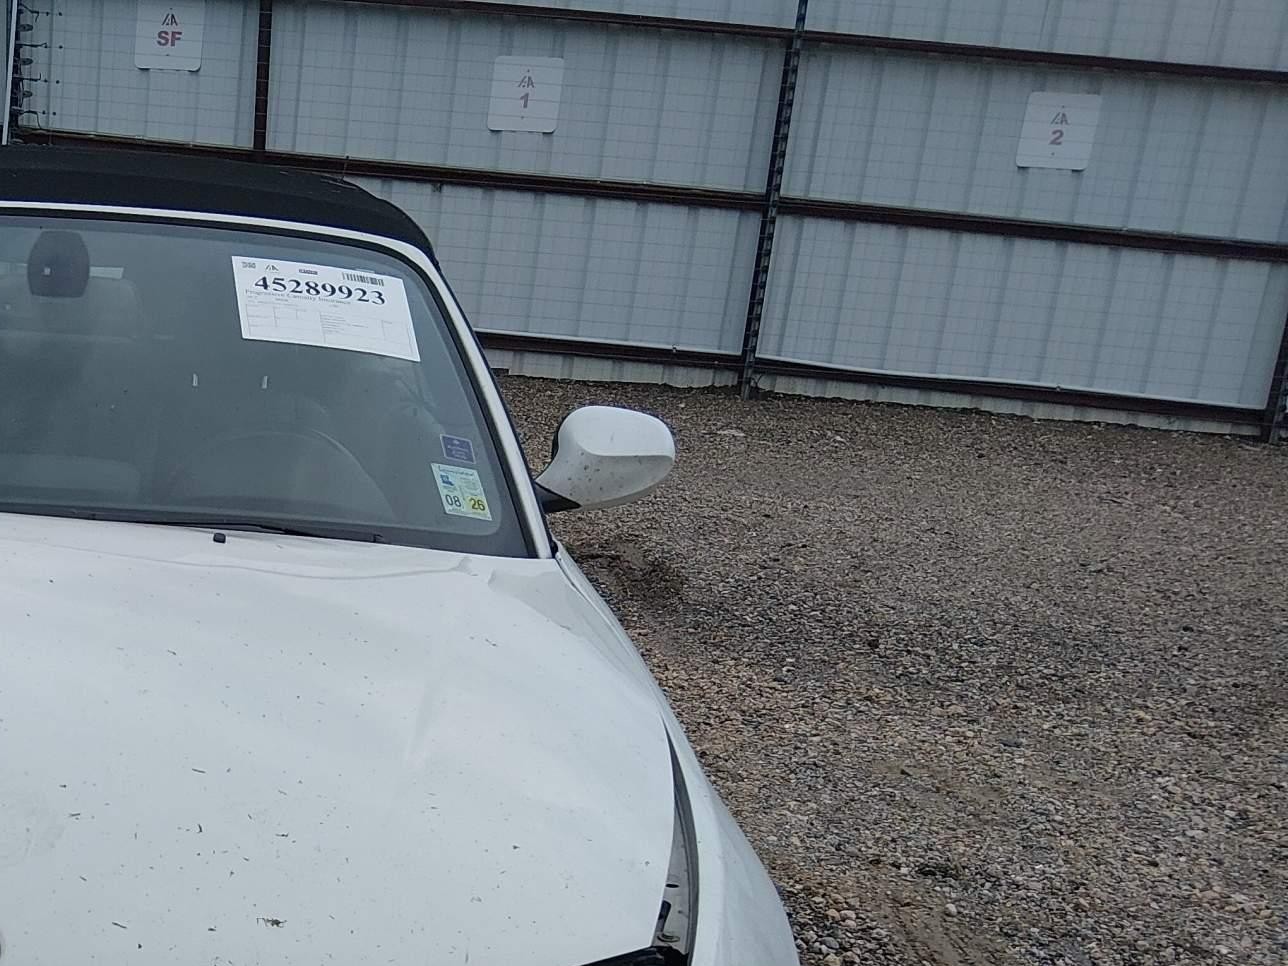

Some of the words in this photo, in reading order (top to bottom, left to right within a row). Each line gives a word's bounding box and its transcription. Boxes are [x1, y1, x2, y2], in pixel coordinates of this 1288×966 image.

[156, 30, 183, 47] SF
[520, 92, 529, 108] 1
[1049, 129, 1064, 145] 2
[254, 276, 386, 306] 45289923
[445, 494, 462, 508] 08
[469, 497, 486, 512] 26
